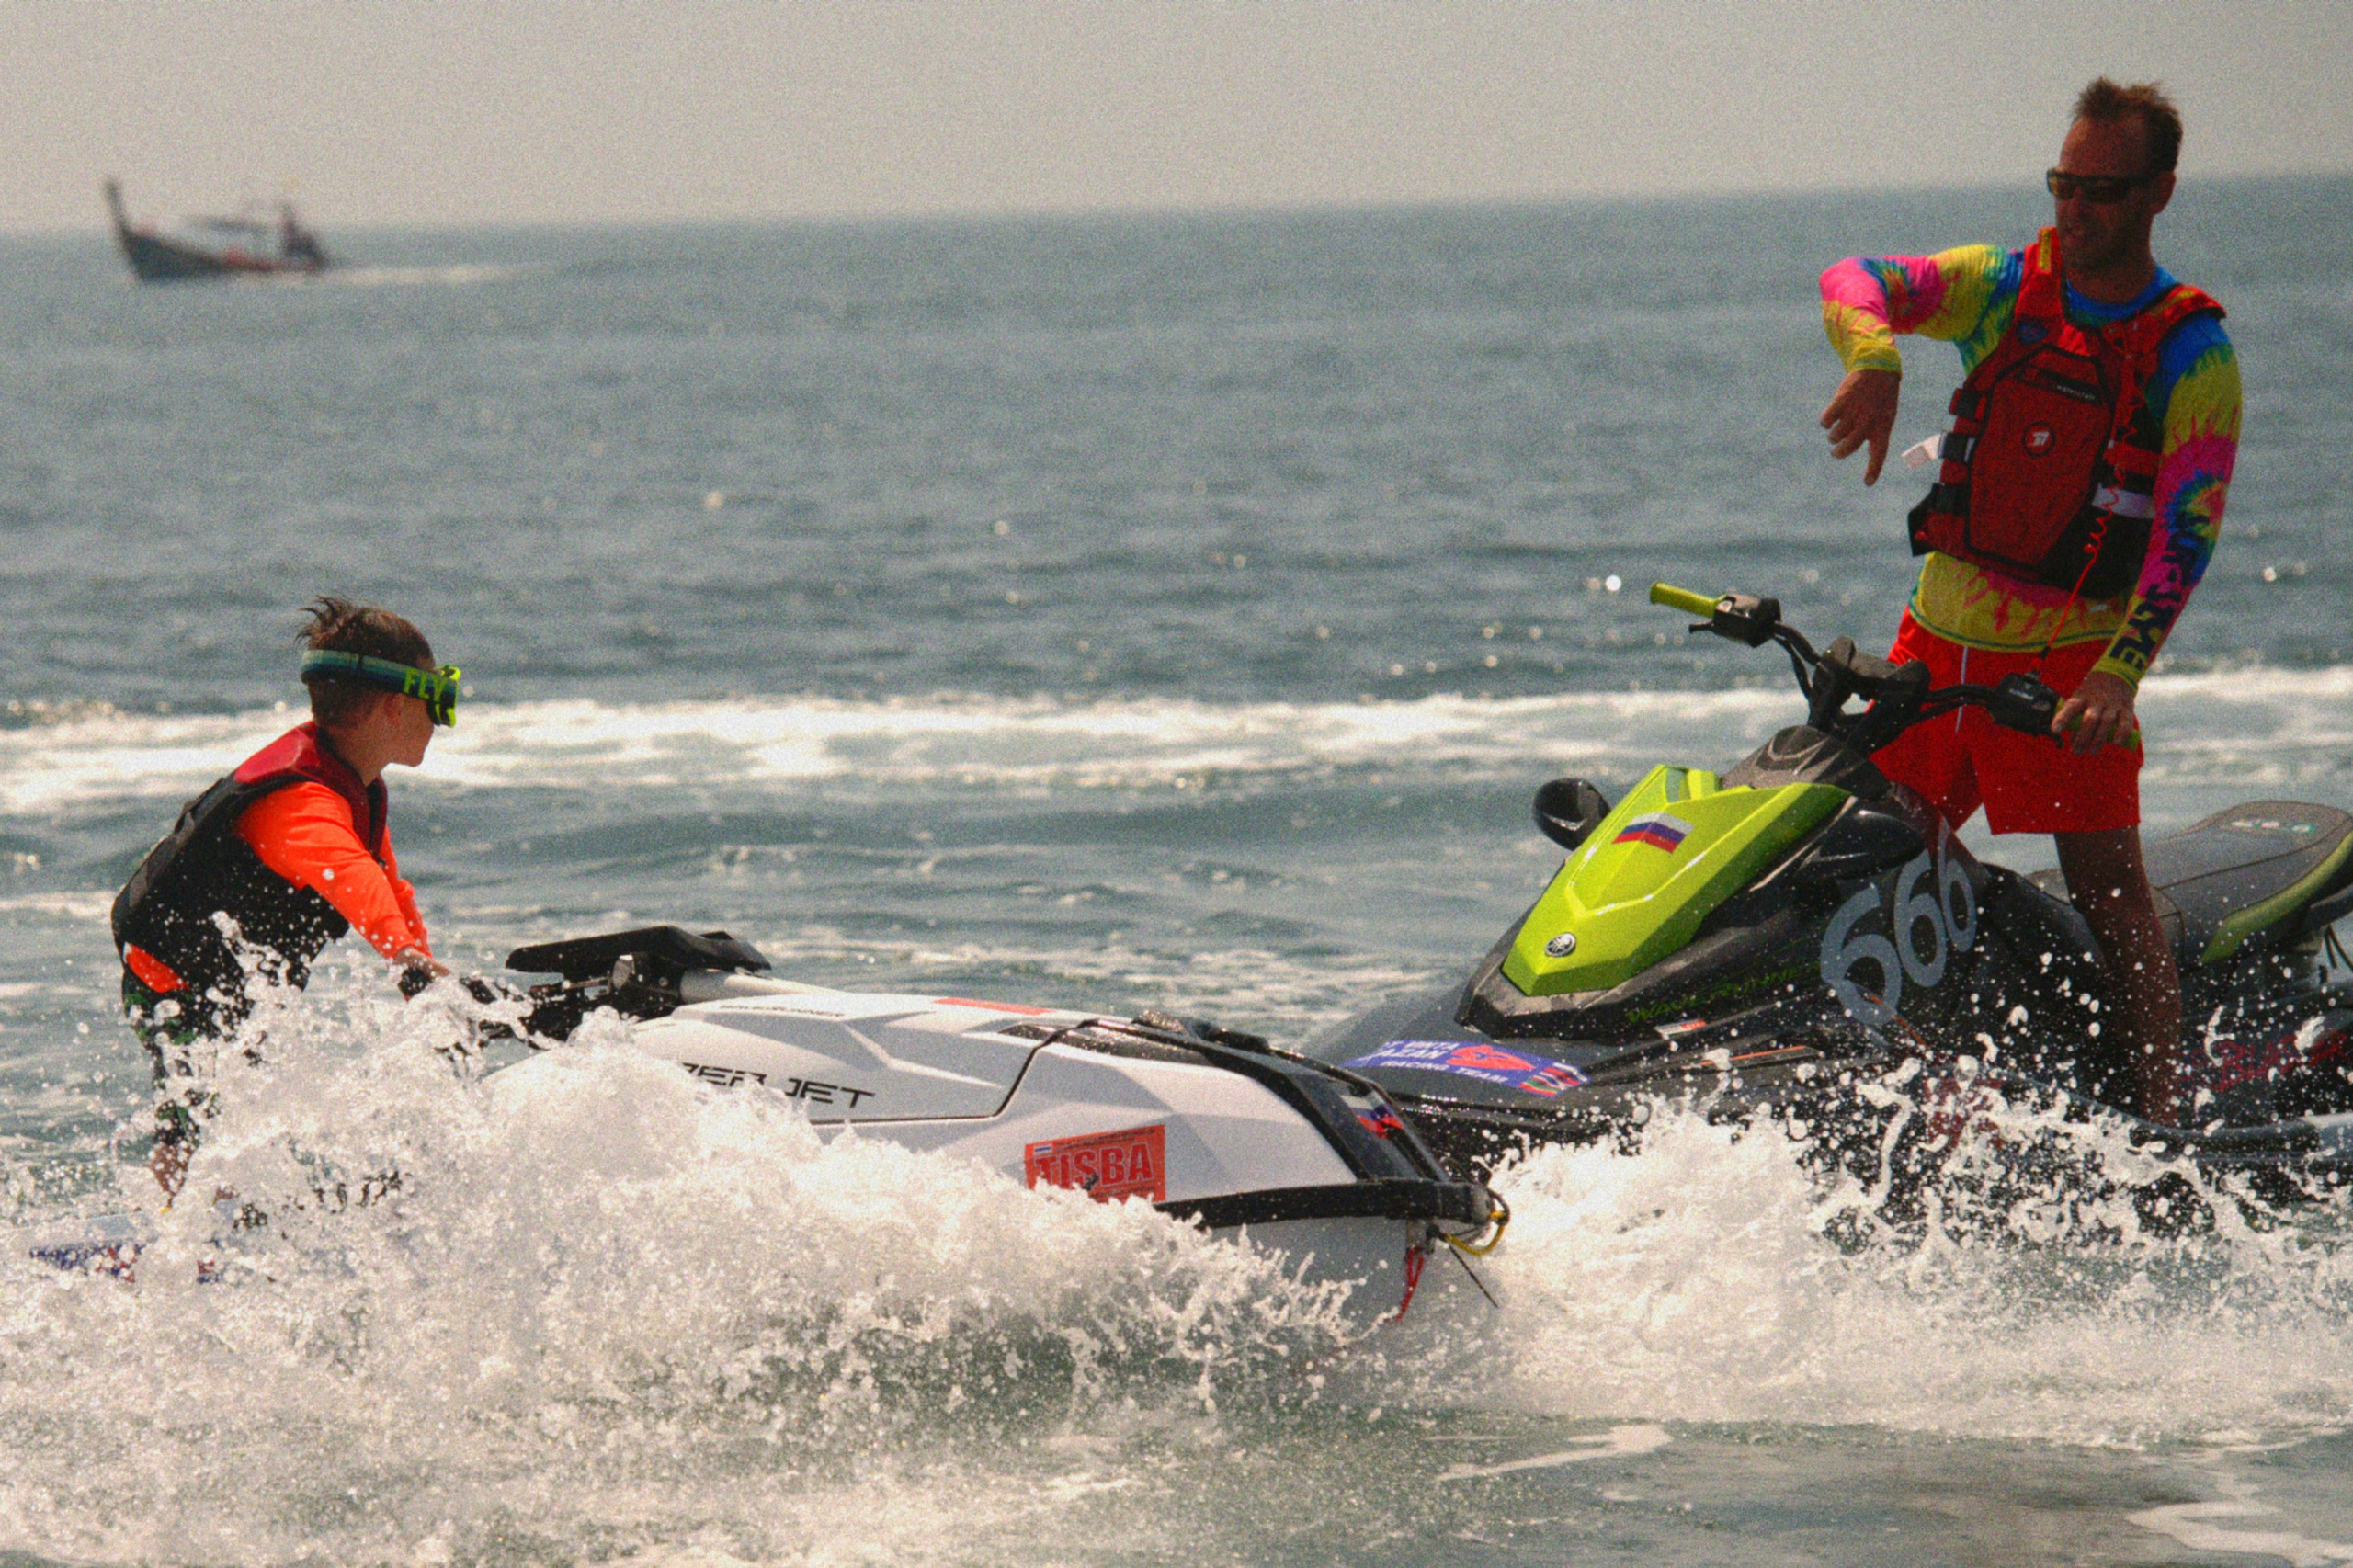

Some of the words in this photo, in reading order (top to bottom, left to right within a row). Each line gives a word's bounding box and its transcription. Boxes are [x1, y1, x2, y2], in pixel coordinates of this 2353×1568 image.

[404, 667, 447, 701] FLY
[1820, 814, 1977, 1026] 666
[784, 1077, 875, 1109] JET
[1033, 1142, 1155, 1190] TISBA
